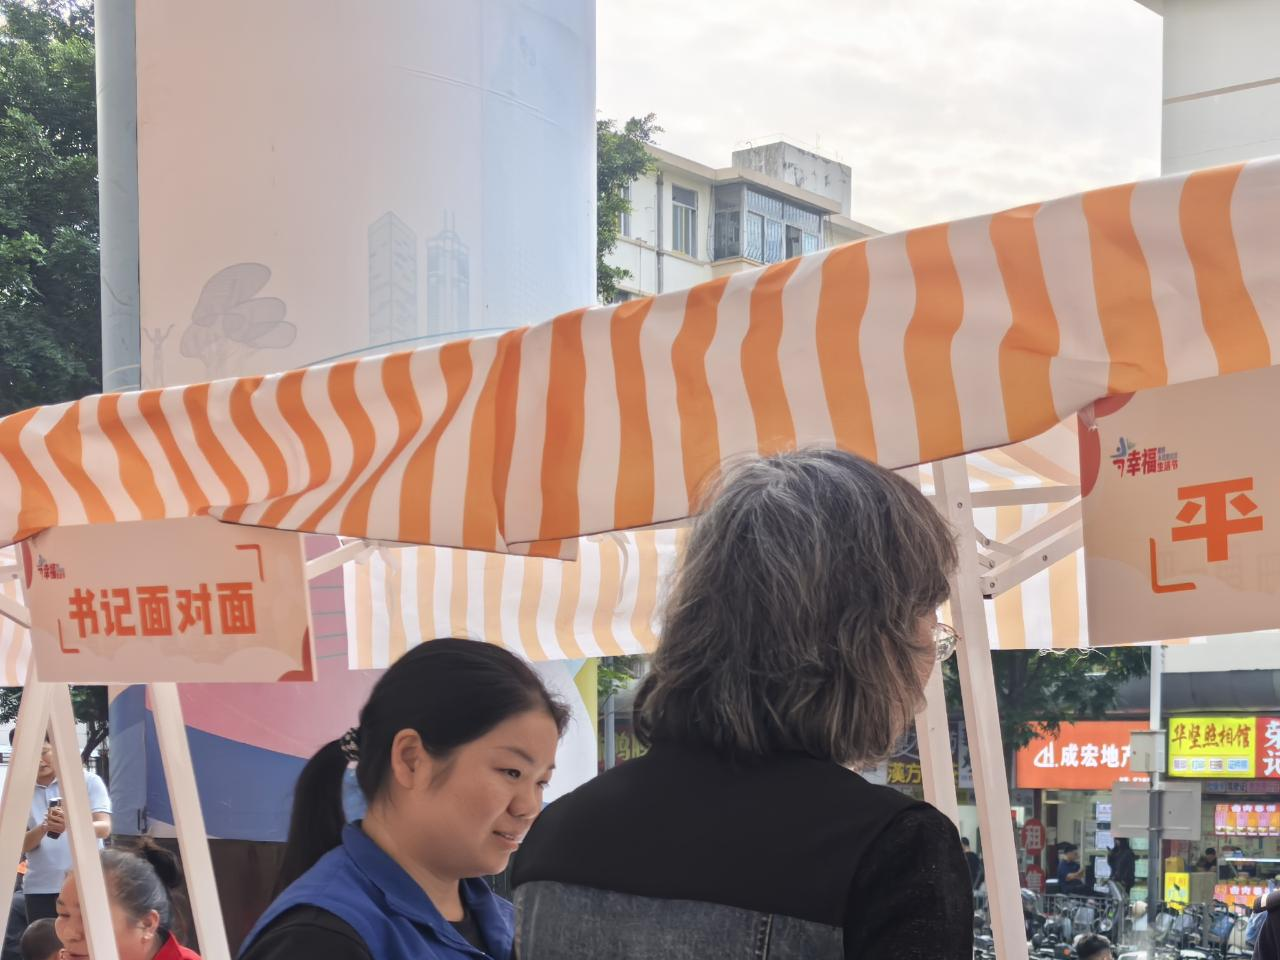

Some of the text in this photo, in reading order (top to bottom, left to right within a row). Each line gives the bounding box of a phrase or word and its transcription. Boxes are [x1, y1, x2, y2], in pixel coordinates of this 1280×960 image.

[1127, 448, 1157, 476] 幸福
[68, 581, 257, 639] 书记面对面
[1171, 723, 1251, 750] 华坚照相馆
